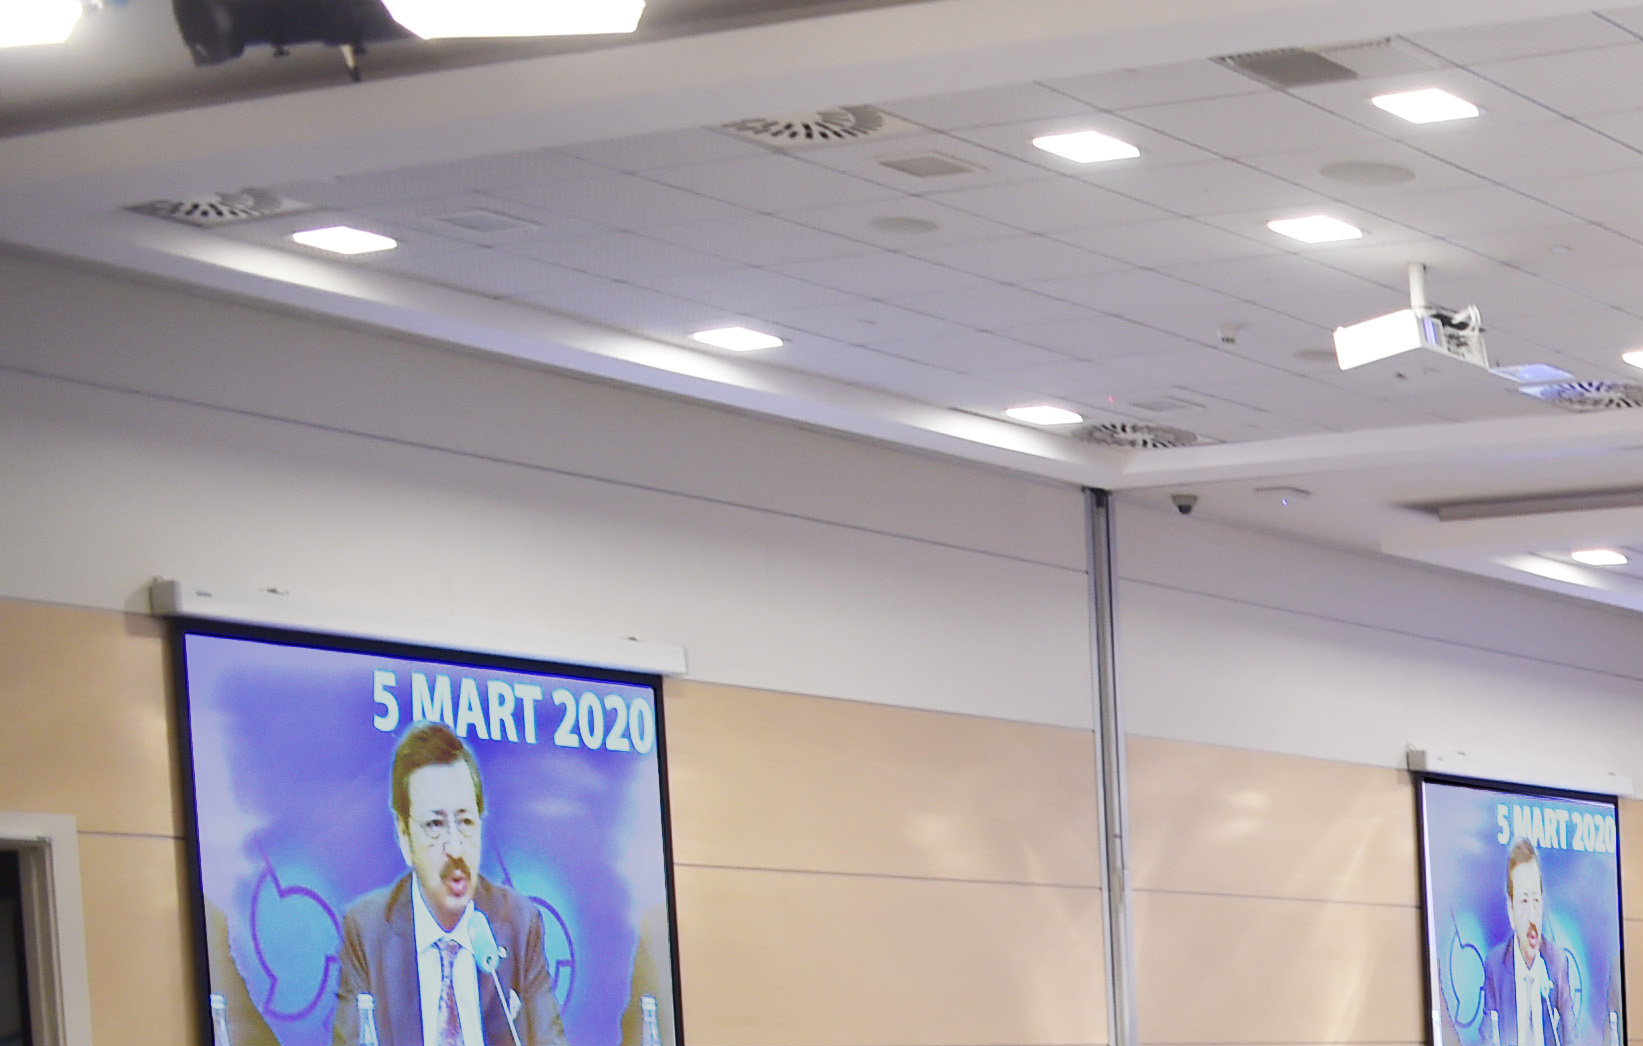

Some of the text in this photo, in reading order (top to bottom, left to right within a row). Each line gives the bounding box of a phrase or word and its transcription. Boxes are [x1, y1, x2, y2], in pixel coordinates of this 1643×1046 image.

[372, 669, 655, 754] 5 MART 2020
[1497, 804, 1616, 853] 5 MART 2020
